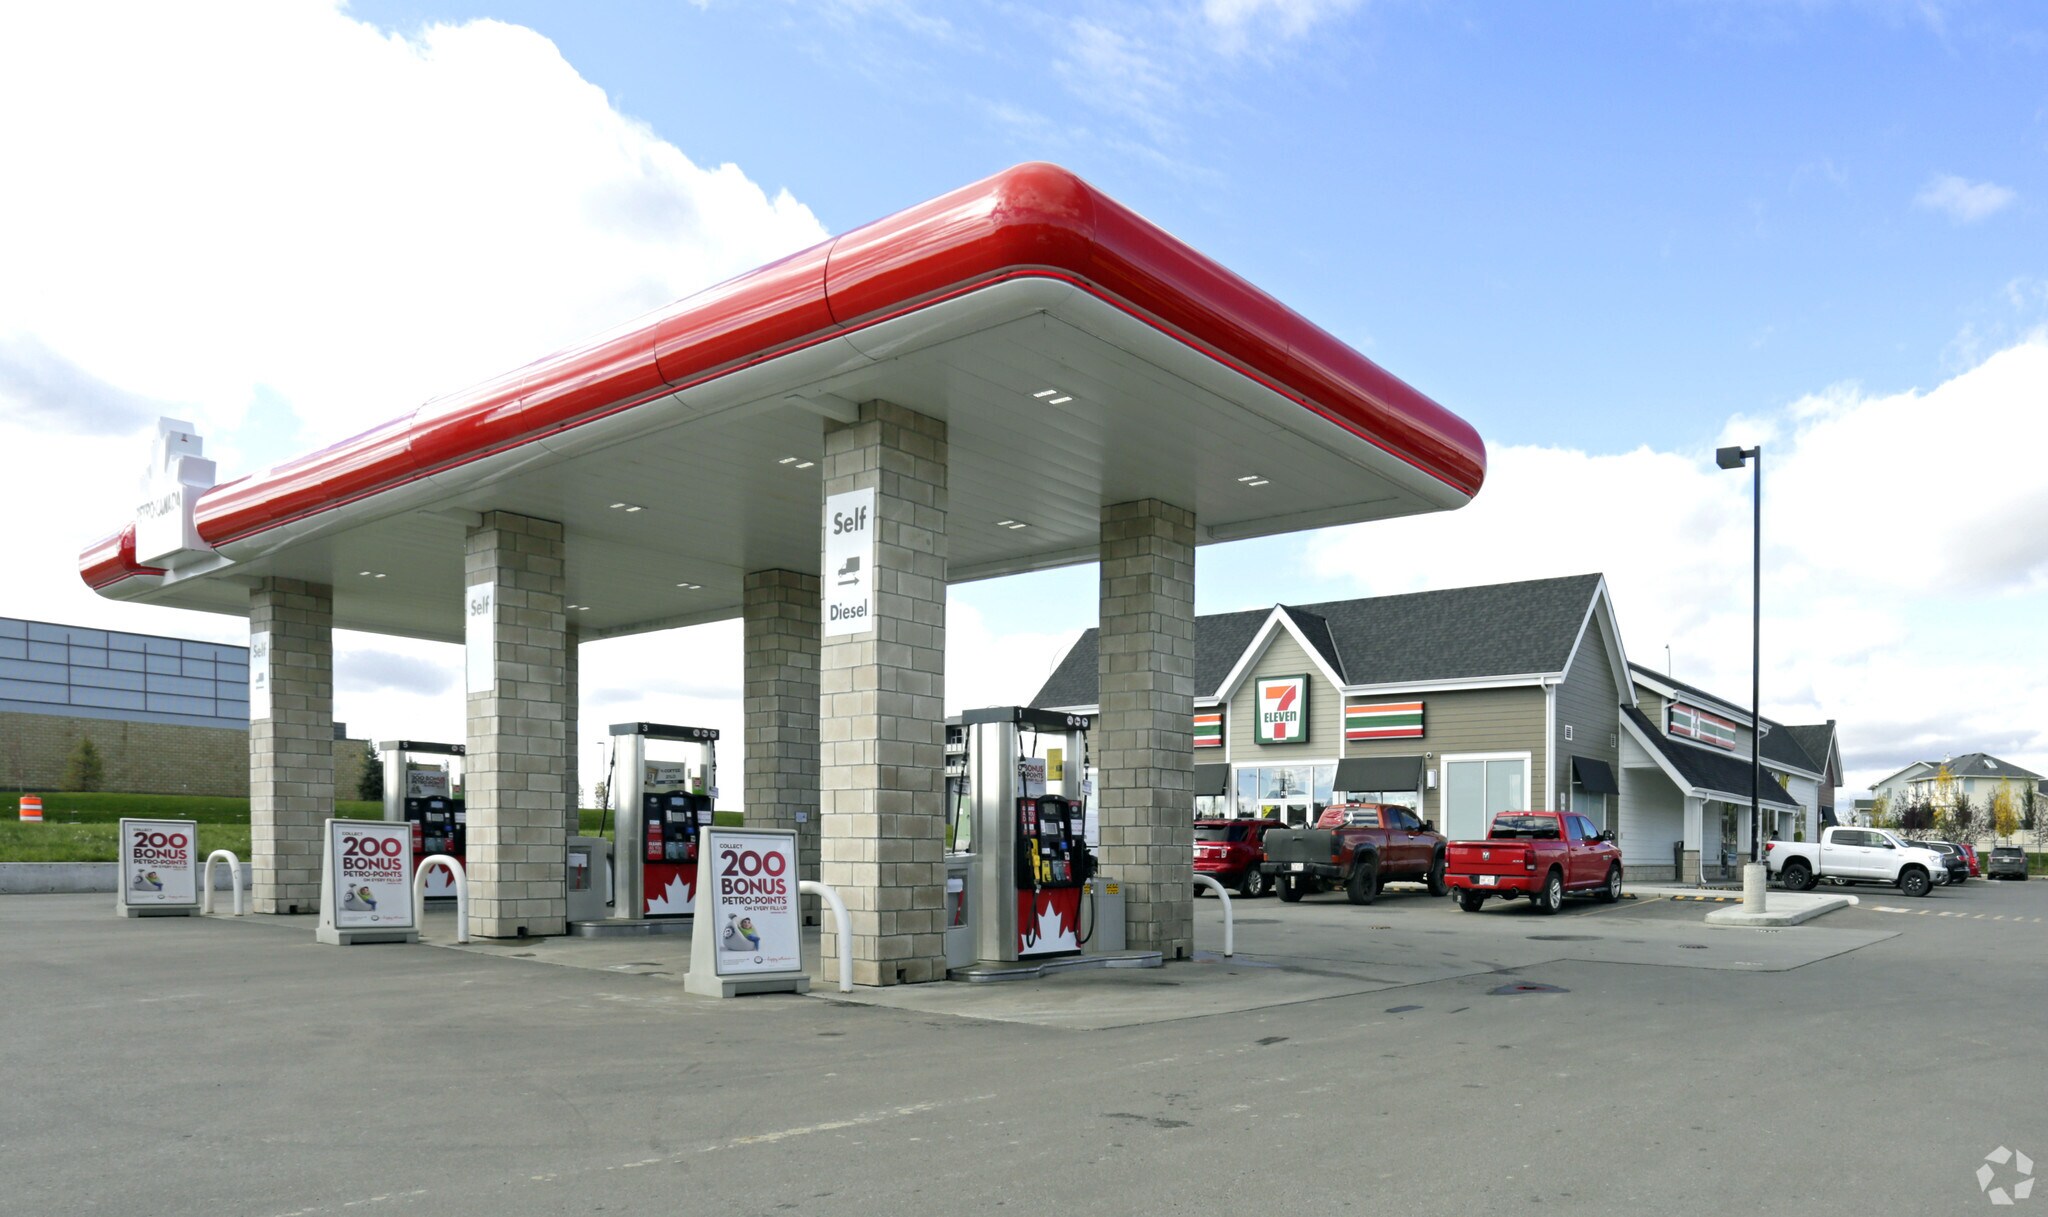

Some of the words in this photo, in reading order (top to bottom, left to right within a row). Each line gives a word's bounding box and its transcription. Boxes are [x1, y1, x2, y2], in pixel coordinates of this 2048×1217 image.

[833, 505, 867, 535] Self
[471, 595, 490, 616] Self
[830, 598, 868, 621] Diesel
[253, 642, 266, 658] Self
[1265, 685, 1297, 738] 7
[642, 724, 648, 732] 3
[133, 832, 188, 848] 200
[342, 836, 402, 857] 200
[133, 848, 187, 860] BONUS
[343, 857, 402, 871] BONUS
[720, 849, 786, 877] 200
[343, 870, 402, 878] PETRO-POINTS
[721, 878, 787, 895] BONUS
[722, 896, 787, 905] PETRO-POINTS
